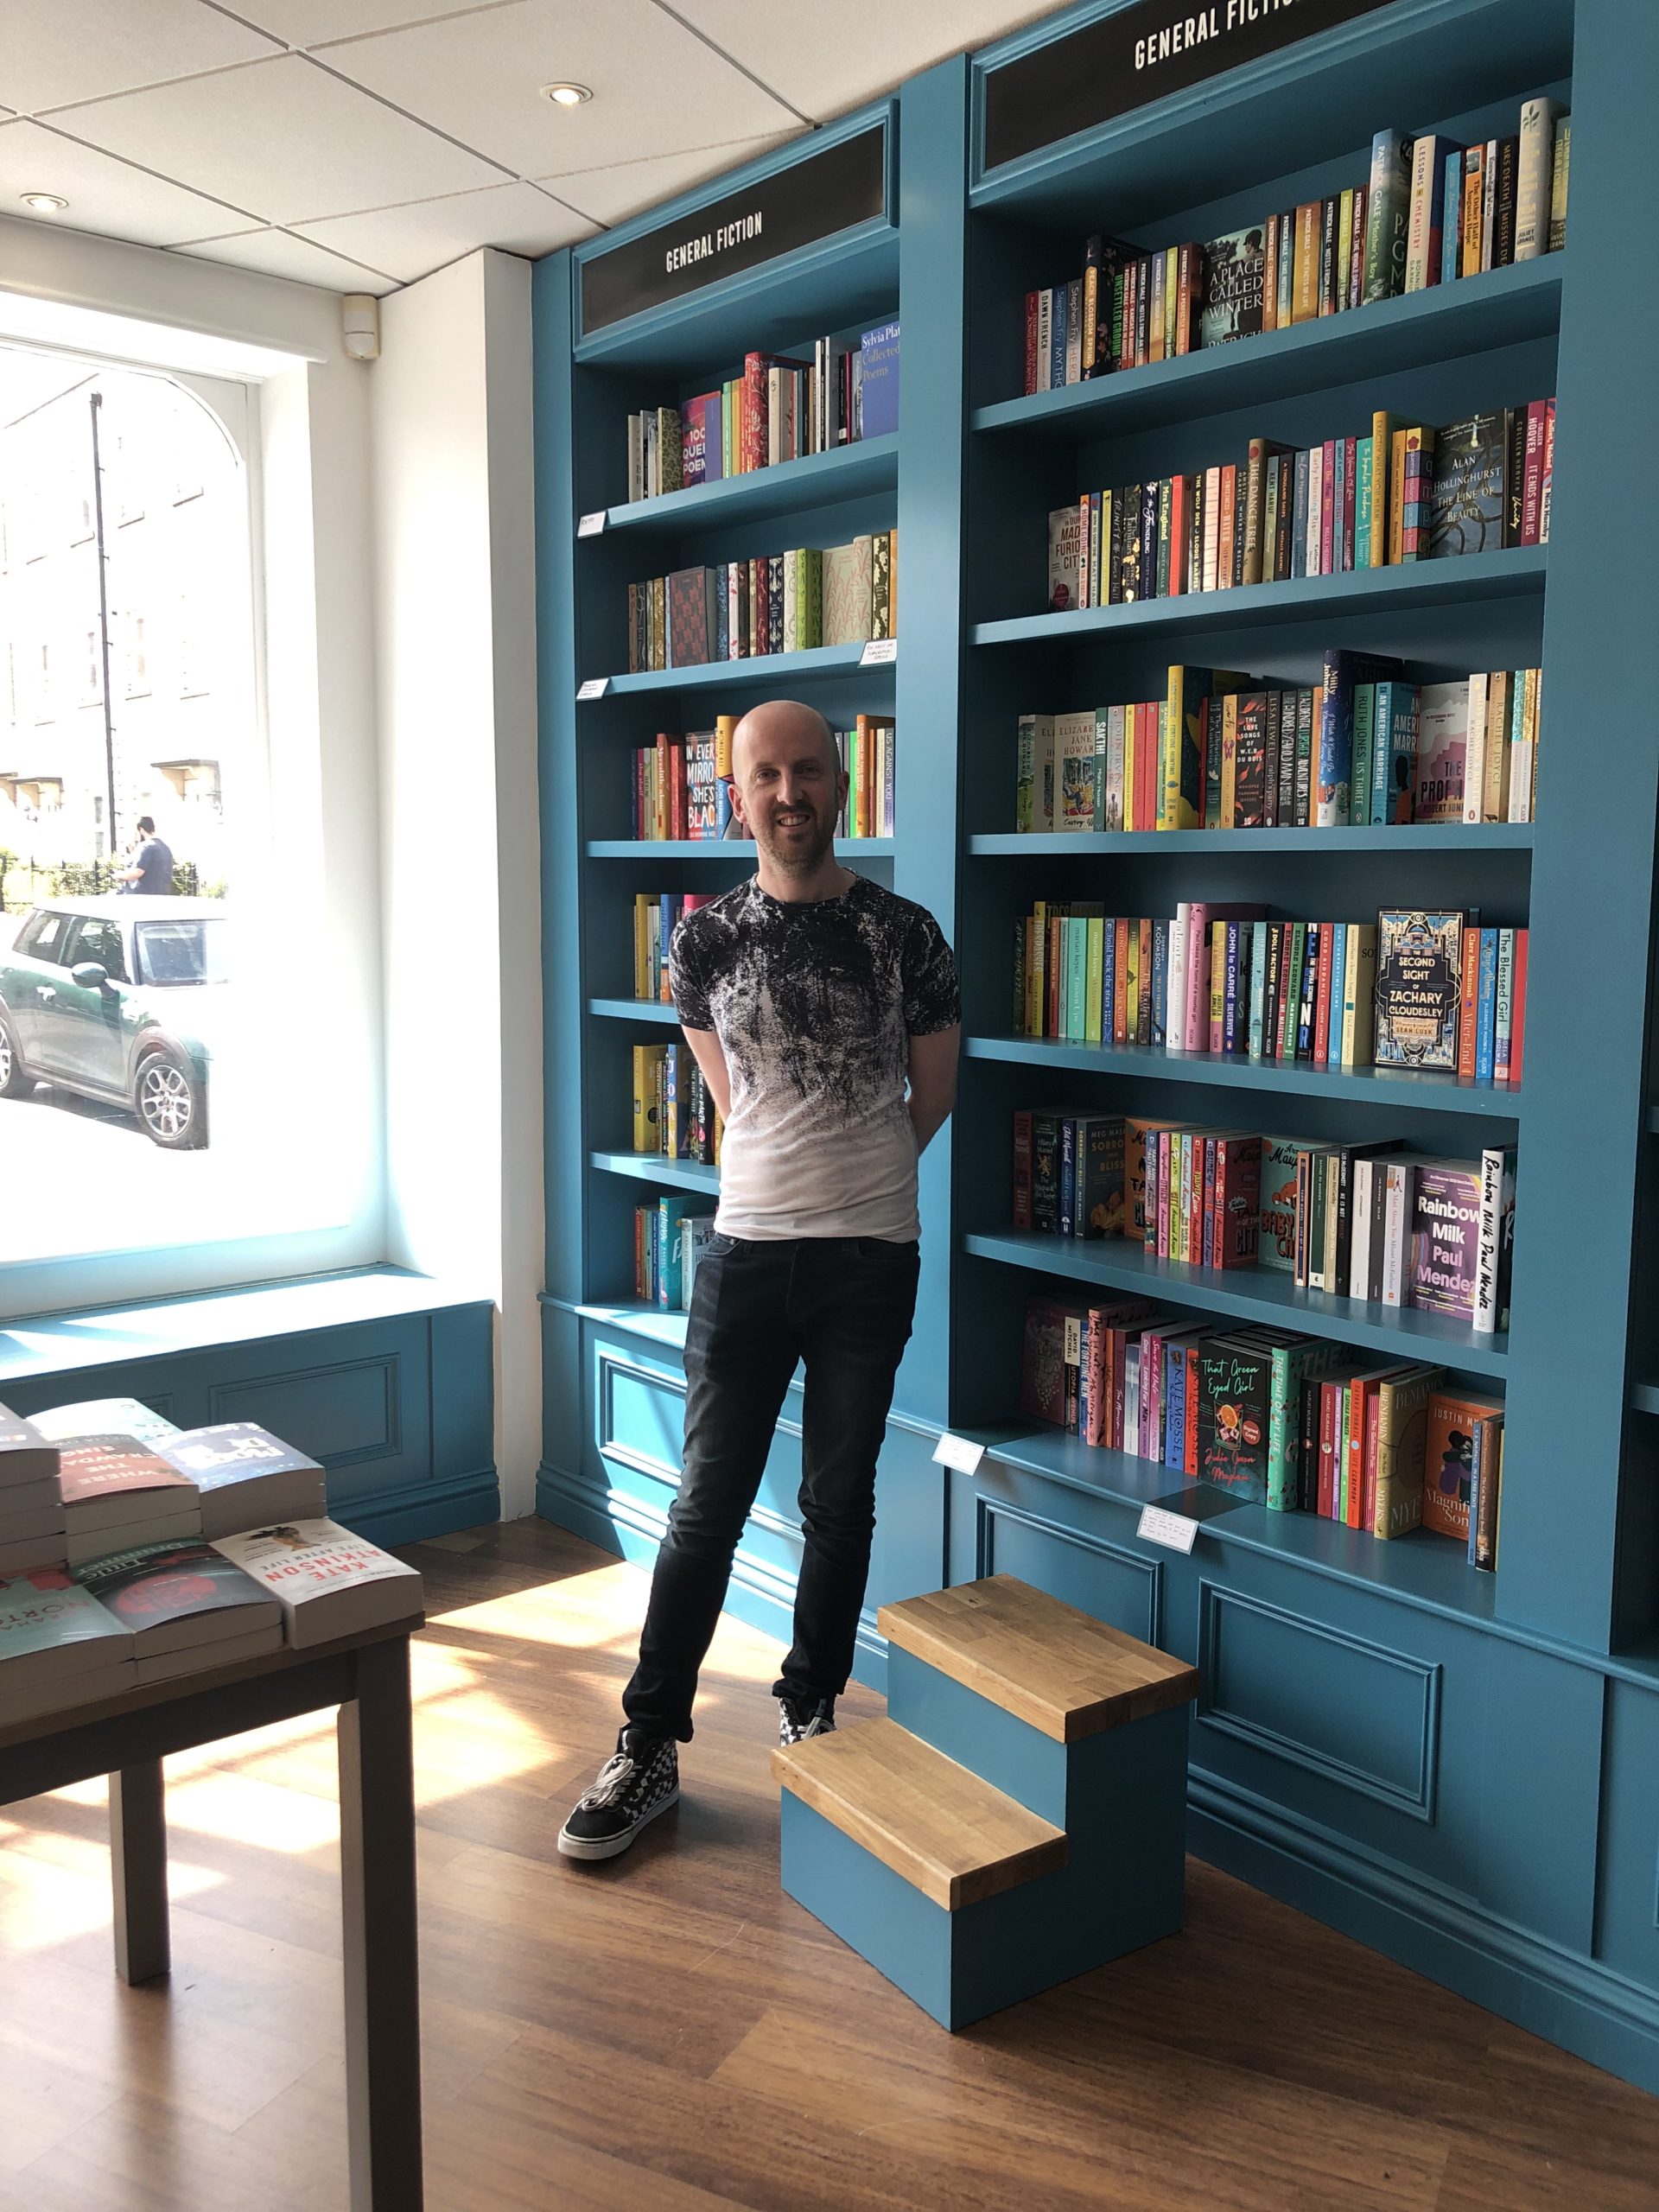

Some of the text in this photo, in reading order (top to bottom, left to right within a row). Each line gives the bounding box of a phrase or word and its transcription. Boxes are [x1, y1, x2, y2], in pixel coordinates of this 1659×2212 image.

[1135, 7, 1219, 70] GENERAL
[1413, 145, 1427, 249] LESSONS CHEMISTRY
[665, 211, 762, 273] GENERAL FICTION
[1472, 240, 1478, 251] of
[1210, 257, 1264, 287] A PLACE
[1209, 275, 1263, 302] CALLED
[1069, 287, 1078, 326] Stephen
[1112, 275, 1123, 356] UNSETTLED GROUND
[1209, 295, 1264, 320] WINTER
[862, 332, 885, 353] Sylvia
[1069, 327, 1078, 342] Fry
[862, 340, 900, 365] Collected
[863, 365, 889, 381] Poems
[1527, 417, 1538, 454] HOOVER
[1452, 455, 1477, 471] ALAN
[1433, 466, 1502, 493] HOLLINGHURST
[1527, 475, 1537, 498] ENDS
[1246, 462, 1260, 549] THE DANCE TREE
[1437, 486, 1495, 508] THE LINE OF
[1160, 504, 1168, 541] England
[1446, 505, 1480, 523] BEAUTY
[1526, 500, 1536, 522] WITH
[1061, 525, 1080, 541] MAD
[1525, 524, 1535, 536] US
[1541, 511, 1550, 537] Hornby
[1323, 663, 1332, 704] Johnson
[1329, 669, 1338, 696] Milly
[886, 733, 893, 745] US
[1071, 735, 1092, 744] JANE
[1096, 721, 1106, 755] SAKTHI
[1239, 732, 1261, 741] SONGS
[686, 745, 693, 760] IN
[1355, 696, 1368, 806] RUTH JONES US THREE
[692, 785, 715, 803] SHE'S
[1228, 926, 1236, 953] JOHN
[1293, 929, 1301, 962] ELMORE
[1228, 955, 1236, 963] le
[1398, 957, 1435, 968] SECOND
[1227, 965, 1236, 999] CARRÉ
[1290, 963, 1299, 1000] LEONARD
[1402, 969, 1431, 981] SIGHT
[1497, 932, 1510, 1023] The Blessed Girl
[1389, 990, 1442, 1006] ZACHARY
[1389, 1005, 1443, 1018] CLOUDESLEY
[1395, 1027, 1414, 1035] SEAN
[1418, 1196, 1481, 1224] Rainbow
[1432, 1222, 1466, 1245] Milk
[1478, 1155, 1500, 1310] Rainbow Milk Paul Mendez
[1433, 1246, 1463, 1268] Paul
[1081, 1346, 1090, 1380] FORTUNE
[1201, 1358, 1260, 1377] That Green
[1080, 1380, 1089, 1398] MEN
[1208, 1375, 1255, 1400] Eyed Girl
[1173, 1368, 1183, 1453] KATE MOSSE
[1433, 1407, 1463, 1425] JUSTIN
[1243, 1425, 1259, 1434] Signed
[1244, 1432, 1256, 1440] Copy
[1376, 1391, 1389, 1522] BENJAMIN MYERS
[78, 1467, 158, 1487] WHERE
[84, 1462, 130, 1475] THE
[257, 1542, 367, 1573] LIFE AFTER LIFE
[263, 1547, 382, 1583] ATKINSON
[309, 1560, 368, 1583] KATE
